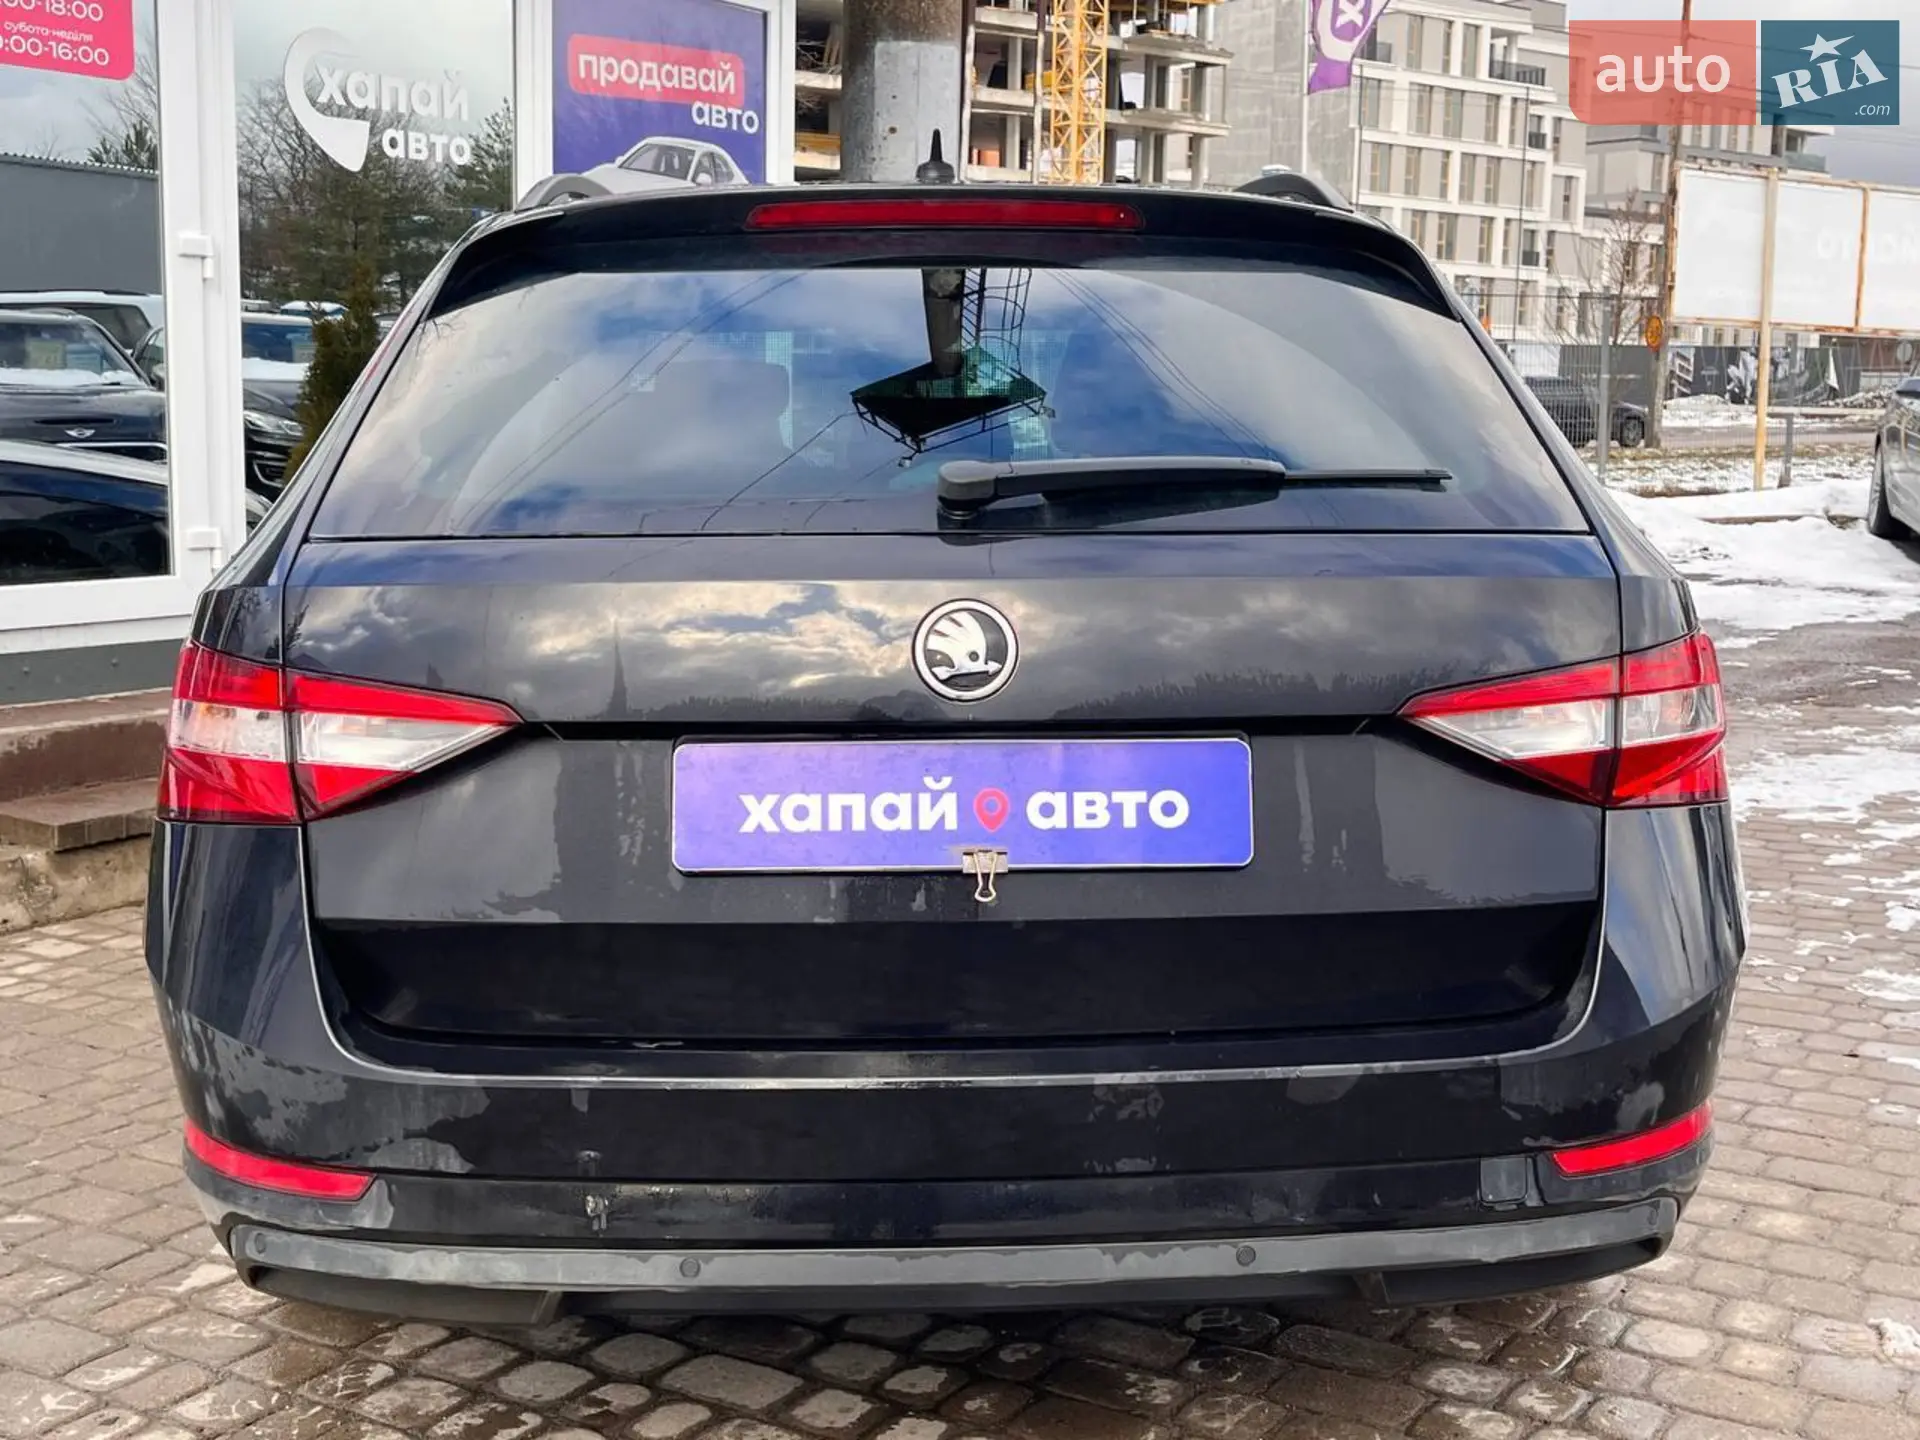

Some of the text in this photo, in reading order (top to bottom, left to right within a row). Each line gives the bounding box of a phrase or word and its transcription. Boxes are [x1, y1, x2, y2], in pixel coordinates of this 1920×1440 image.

[0, 35, 109, 65] :00-16:00
[578, 54, 735, 94] продавай
[316, 67, 469, 121] хапай
[691, 100, 760, 134] авто
[382, 128, 472, 165] авто
[738, 775, 1190, 834] хапай авто
